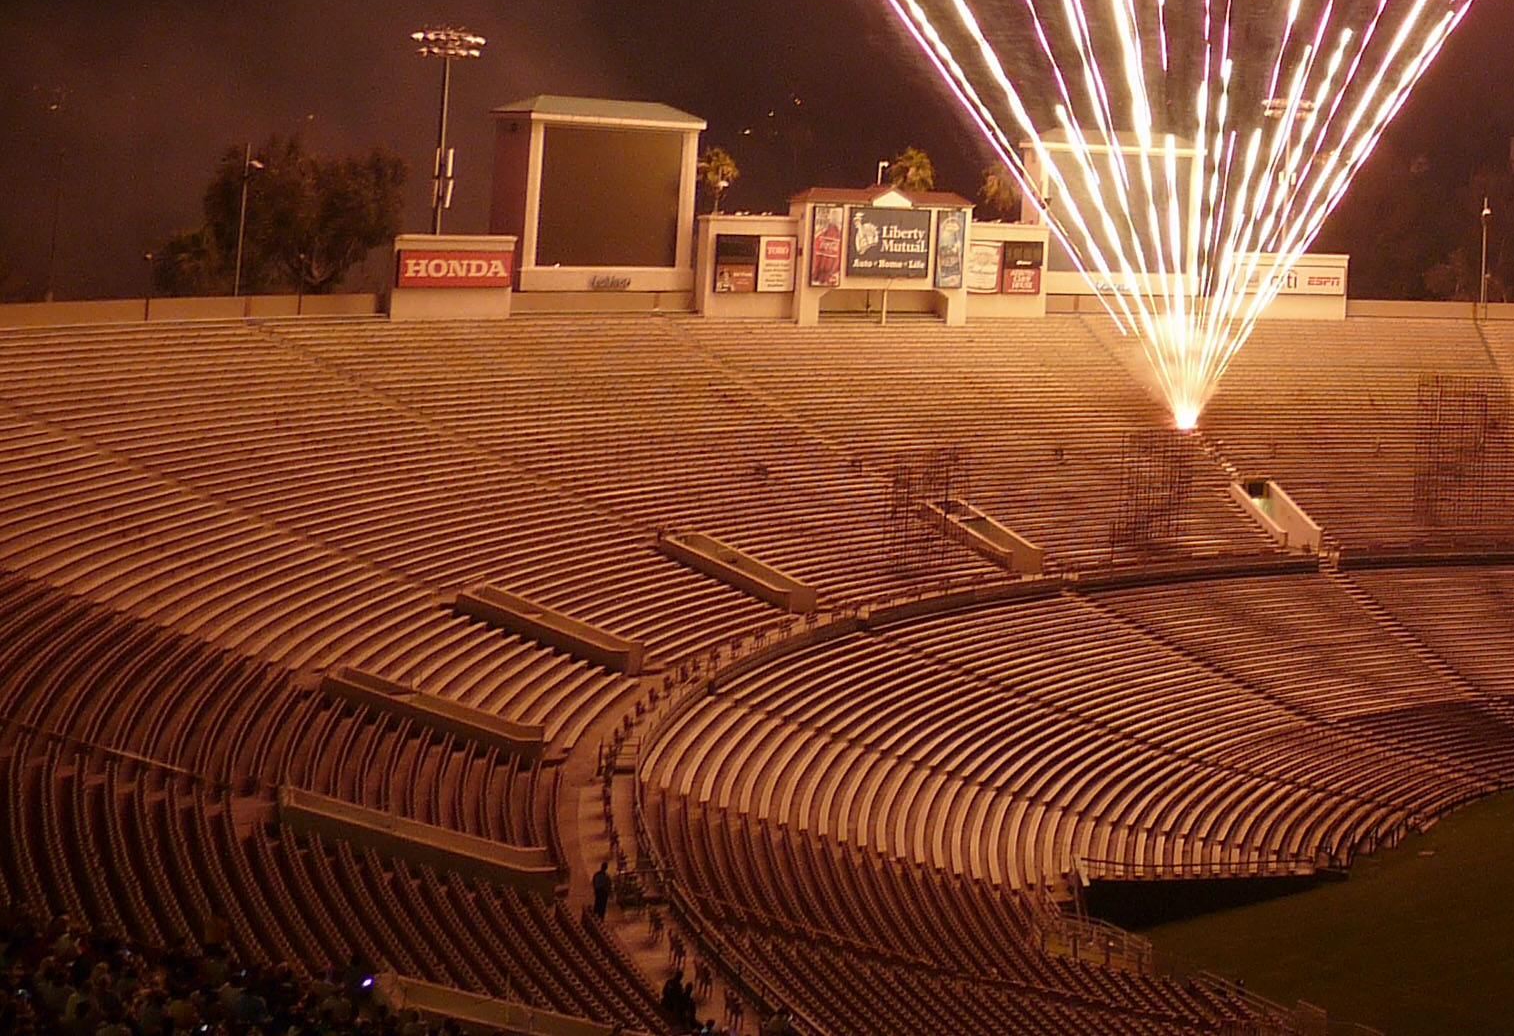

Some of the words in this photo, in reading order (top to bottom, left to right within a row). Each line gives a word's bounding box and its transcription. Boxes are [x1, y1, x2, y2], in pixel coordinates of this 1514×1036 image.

[881, 225, 925, 244] Liberty
[404, 259, 508, 278] HONDA
[853, 259, 873, 268] Auto
[878, 259, 903, 268] Home
[908, 260, 925, 269] Life
[1307, 276, 1341, 286] ESPN
